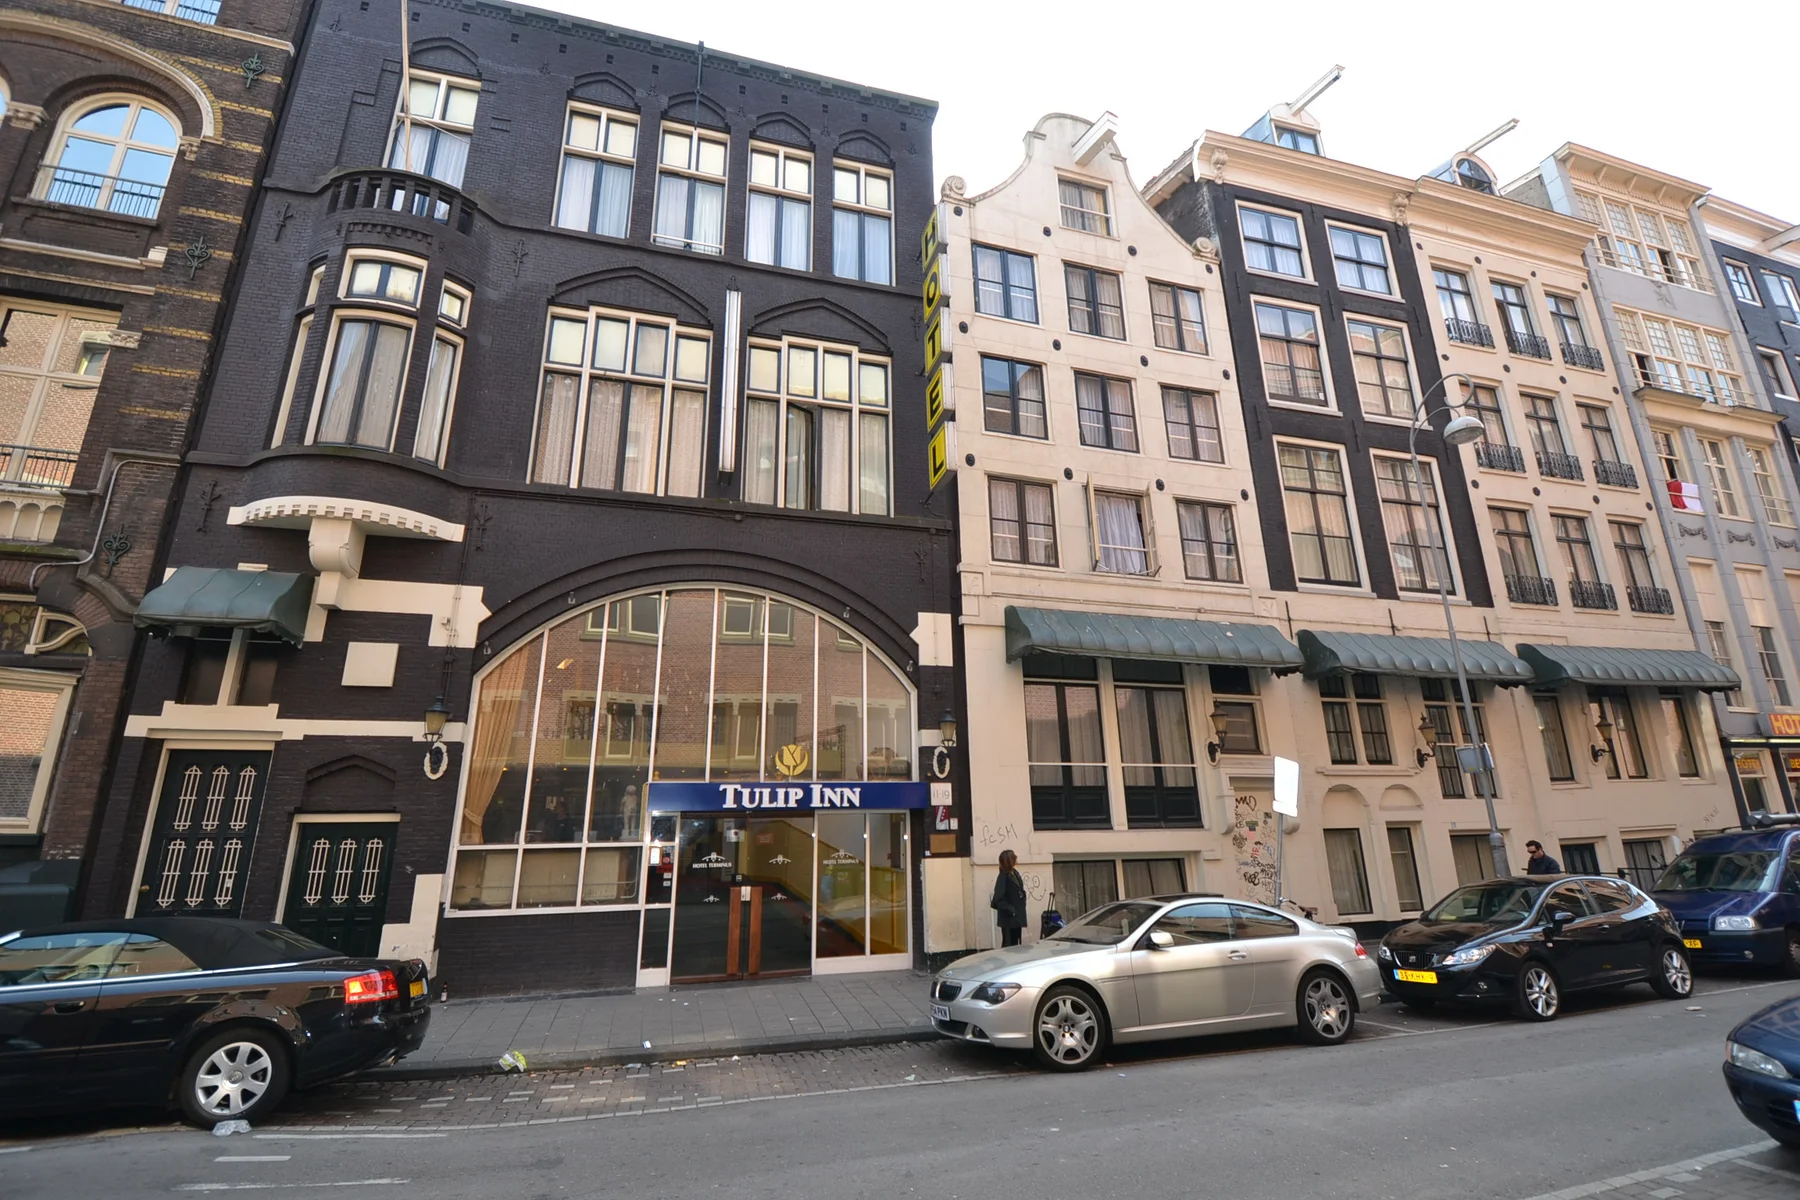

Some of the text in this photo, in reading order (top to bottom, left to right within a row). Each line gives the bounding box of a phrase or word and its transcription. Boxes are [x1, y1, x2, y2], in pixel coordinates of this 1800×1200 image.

[924, 219, 945, 479] HOTEL
[719, 783, 861, 809] TULIP INN
[933, 789, 950, 800] 11-19
